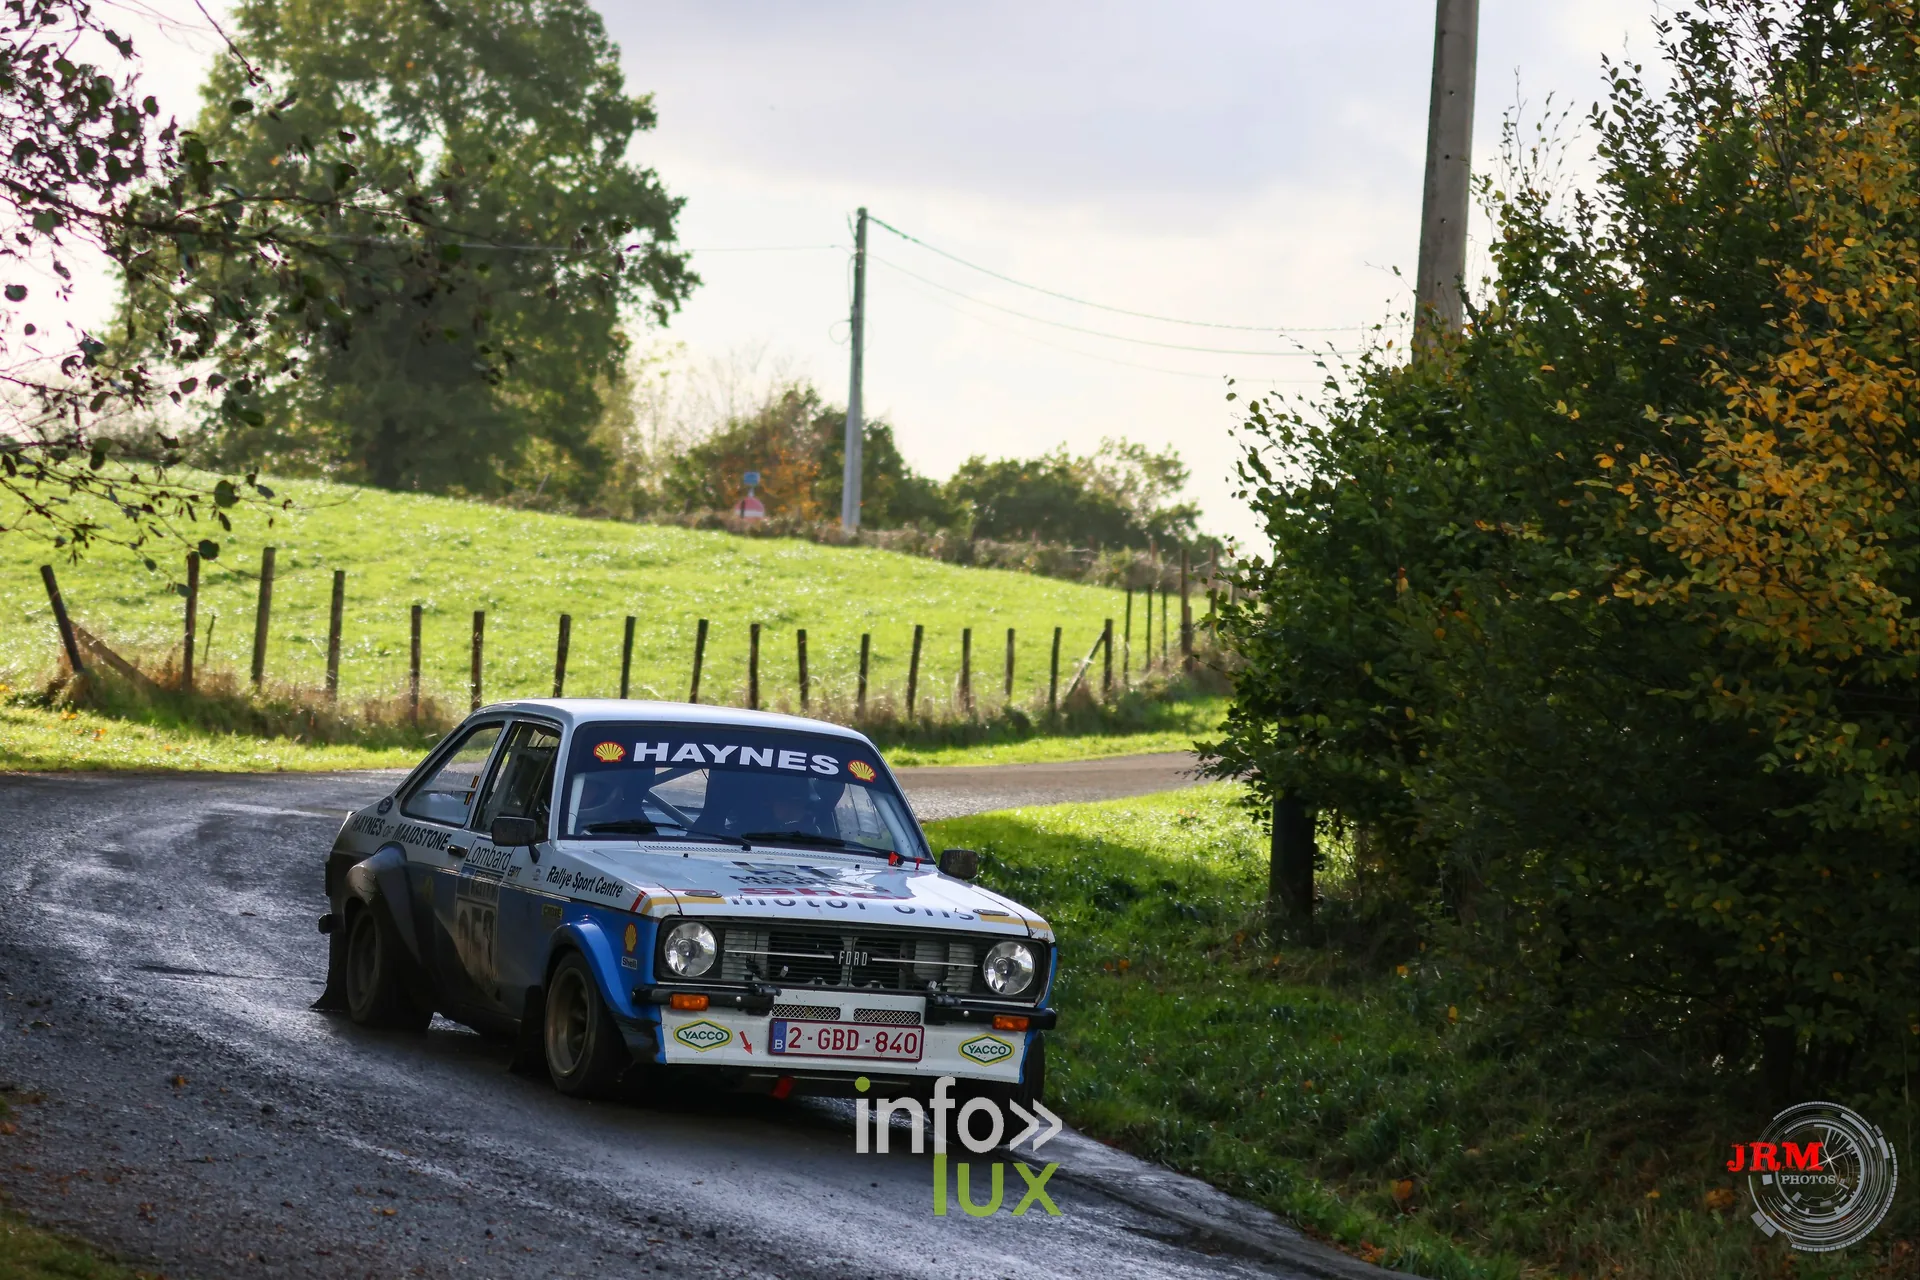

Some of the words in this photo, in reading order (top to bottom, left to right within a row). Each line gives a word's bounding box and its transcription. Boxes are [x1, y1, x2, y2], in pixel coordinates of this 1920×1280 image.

[633, 742, 839, 775] HAYNES
[351, 815, 386, 837] HAYNES
[392, 823, 452, 851] MAIDSTONE
[465, 839, 513, 870] Lombard
[546, 866, 572, 889] Rallye
[574, 872, 595, 893] Sport
[595, 879, 623, 898] Centre
[730, 897, 867, 910] motor
[893, 904, 974, 921] oils
[623, 958, 637, 968] Shell
[838, 951, 868, 966] FORD
[683, 1031, 724, 1041] YACCO
[775, 1039, 783, 1049] B
[968, 1044, 1006, 1055] YACCO
